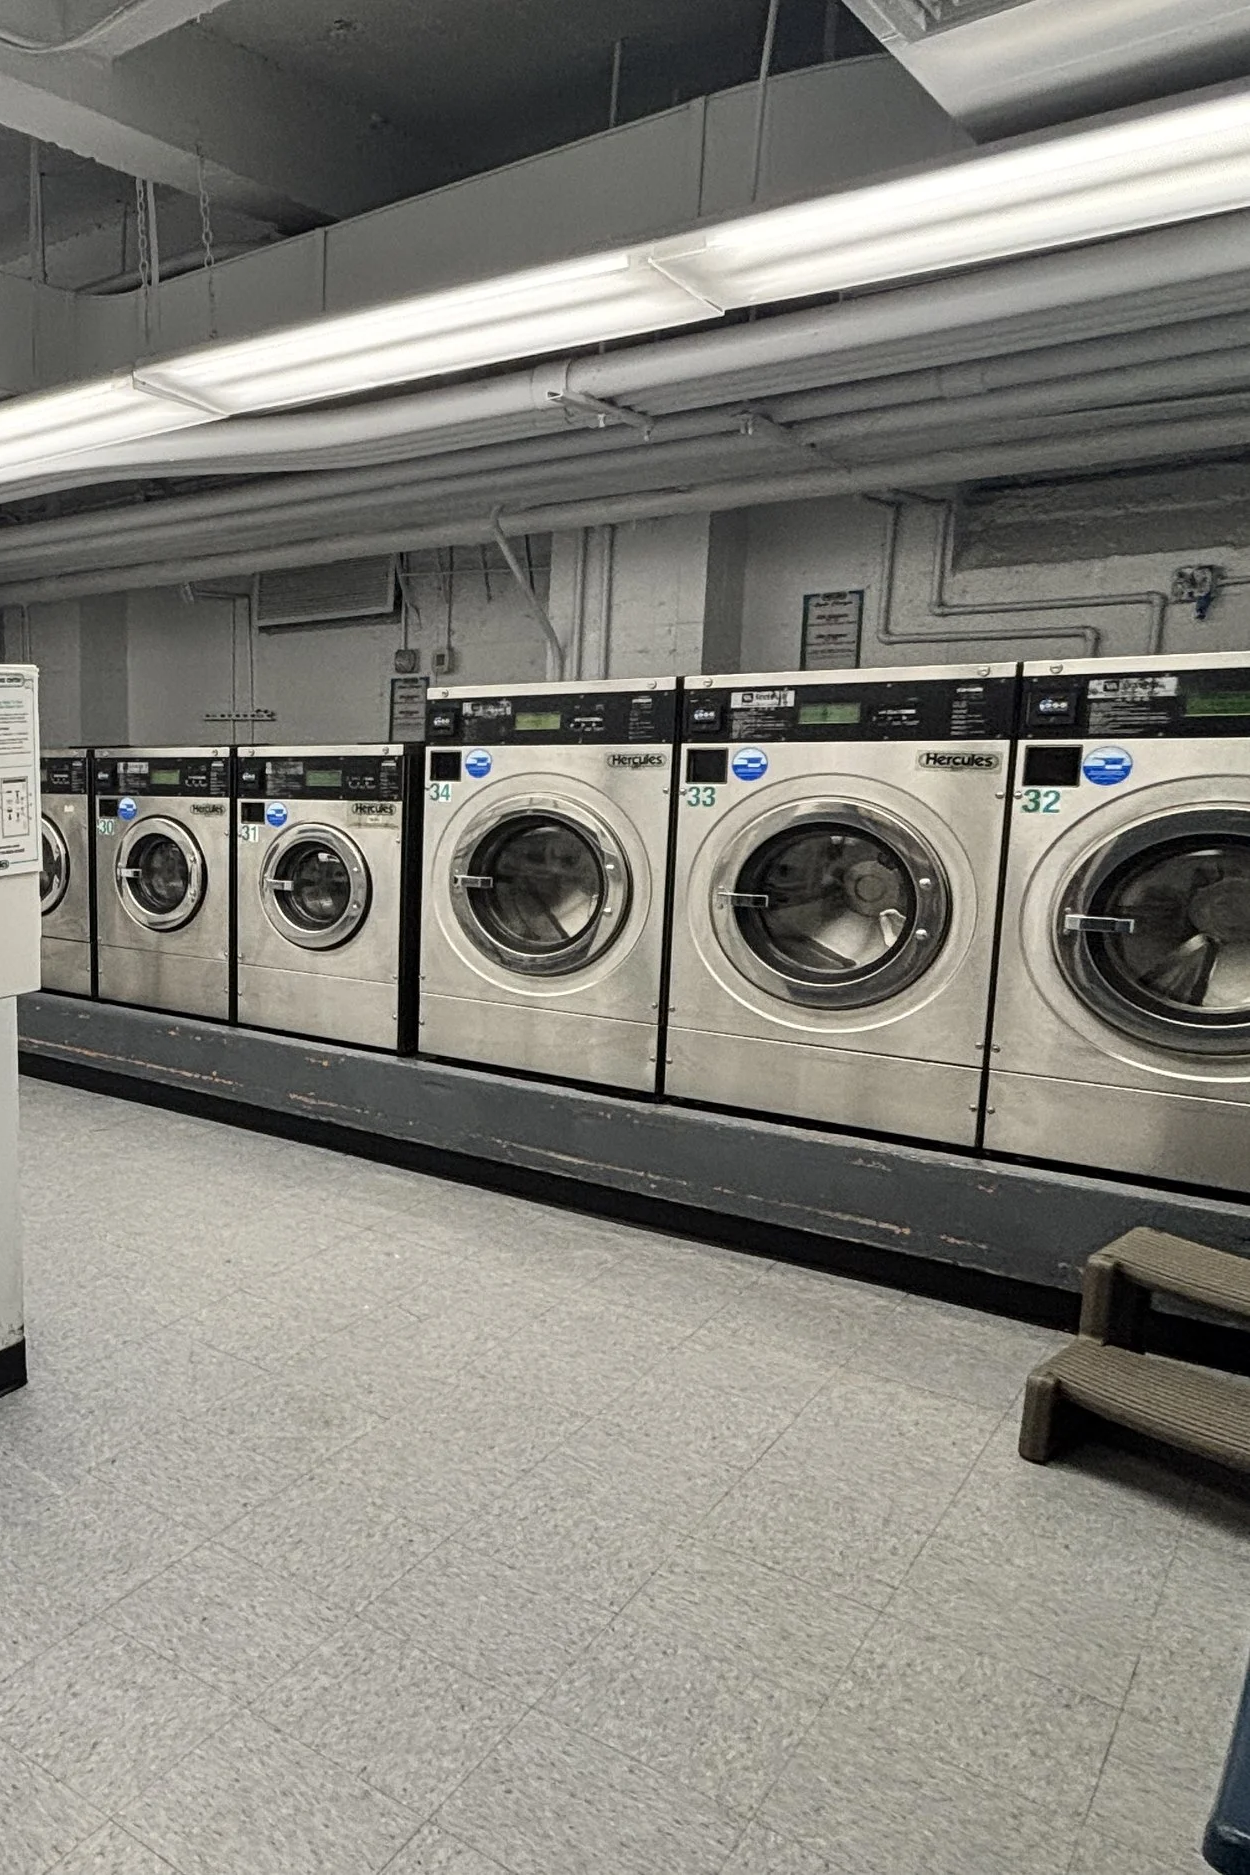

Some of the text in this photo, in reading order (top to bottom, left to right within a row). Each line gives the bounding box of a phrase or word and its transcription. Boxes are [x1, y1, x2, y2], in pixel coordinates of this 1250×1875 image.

[611, 754, 662, 766] Hercules
[925, 752, 993, 768] Hercules
[430, 783, 451, 801] 34
[686, 786, 716, 807] 33
[354, 803, 394, 815] Hercules
[1021, 789, 1061, 814] 32
[99, 821, 114, 834] 30
[241, 826, 258, 841] 31
